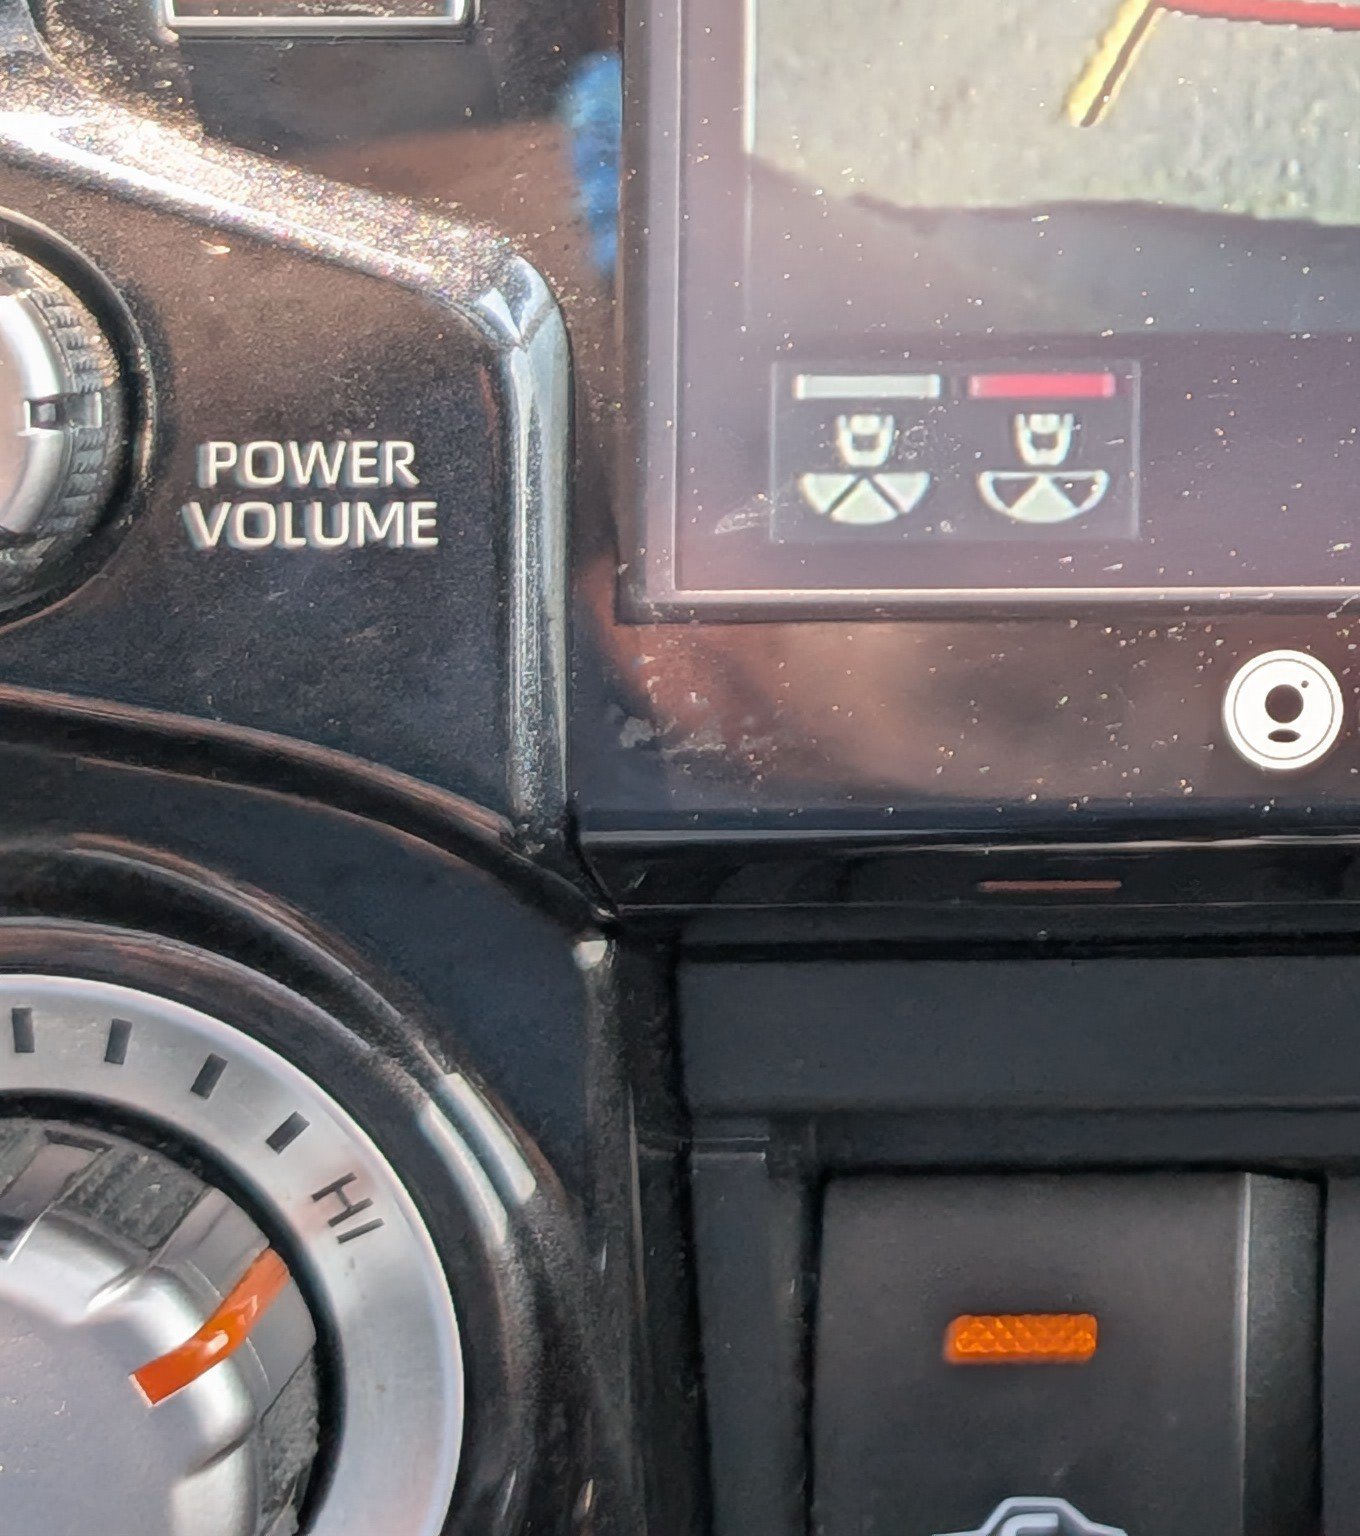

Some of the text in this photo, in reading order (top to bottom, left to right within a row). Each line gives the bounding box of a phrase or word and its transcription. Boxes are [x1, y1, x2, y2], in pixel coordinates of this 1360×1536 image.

[198, 440, 419, 487] POWER
[184, 501, 438, 548] VOLUME
[311, 1171, 385, 1244] HI
